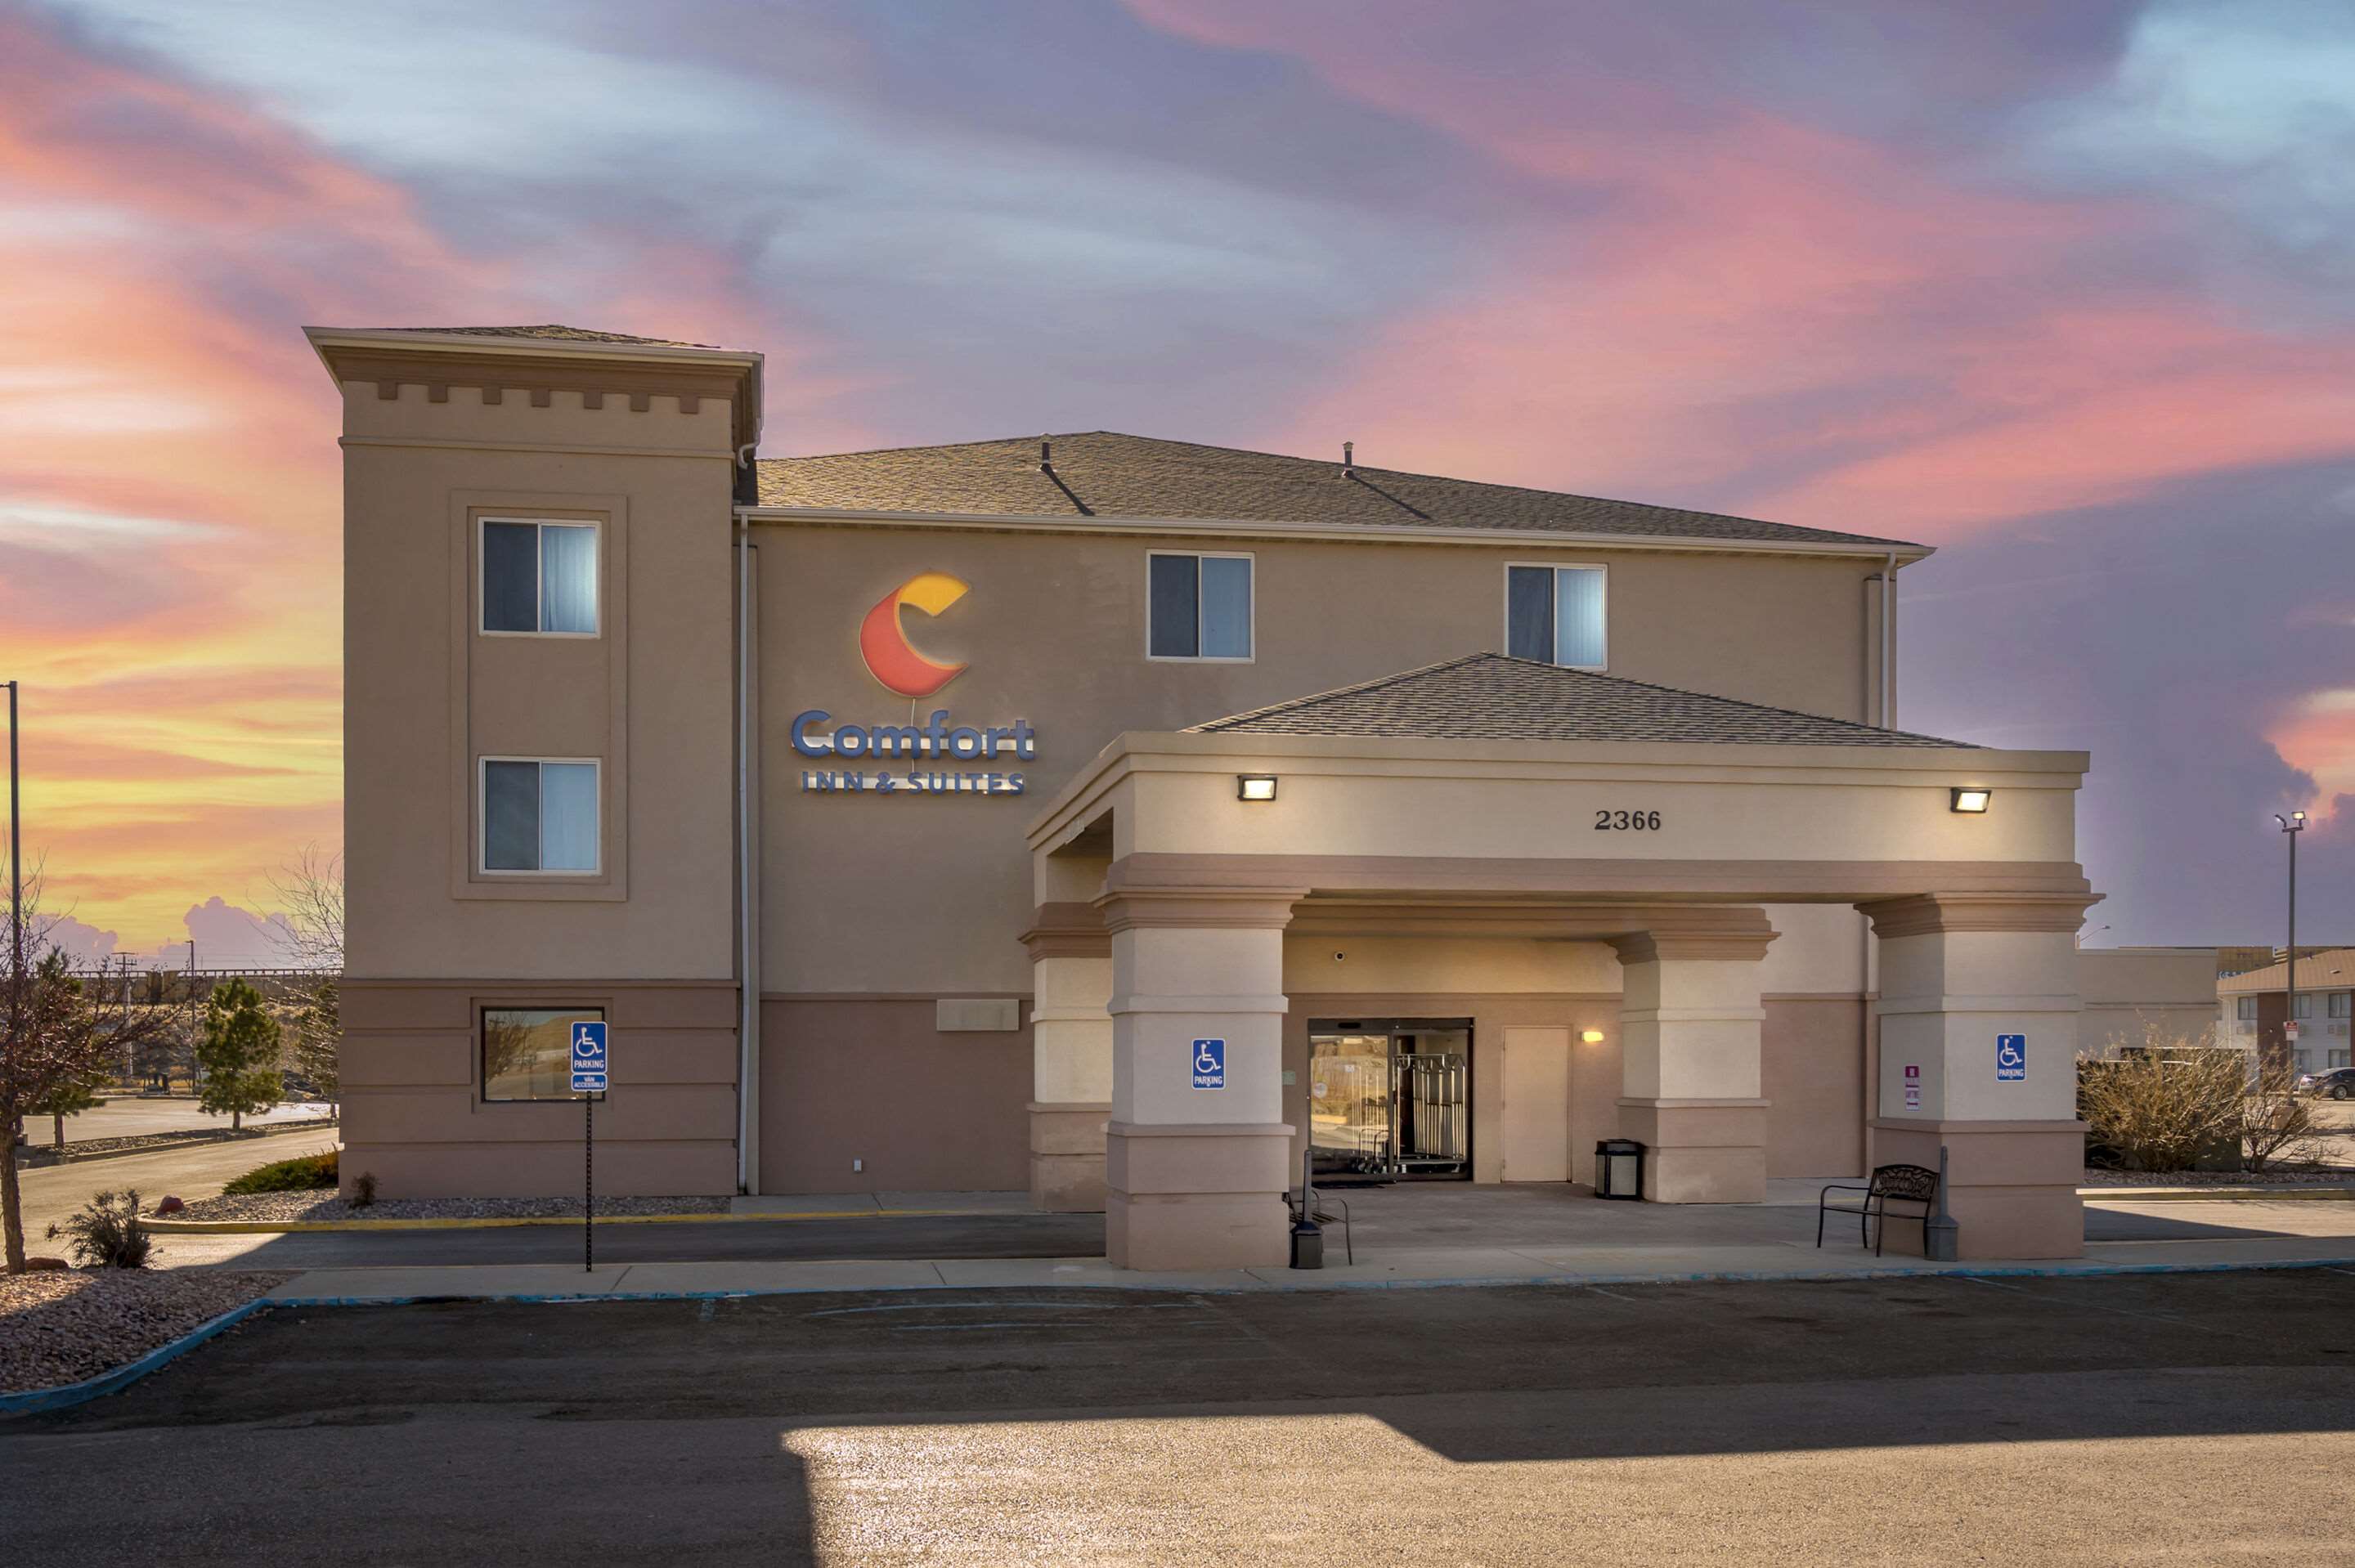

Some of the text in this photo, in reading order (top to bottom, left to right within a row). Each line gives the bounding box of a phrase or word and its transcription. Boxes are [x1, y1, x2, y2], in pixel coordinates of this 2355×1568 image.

[792, 710, 1034, 760] Comfort
[802, 771, 1025, 795] INN & SUITES
[1594, 810, 1661, 831] 2366
[574, 1060, 604, 1068] PARKING
[1998, 1069, 2024, 1077] PARKING
[1194, 1077, 1222, 1085] PARKING
